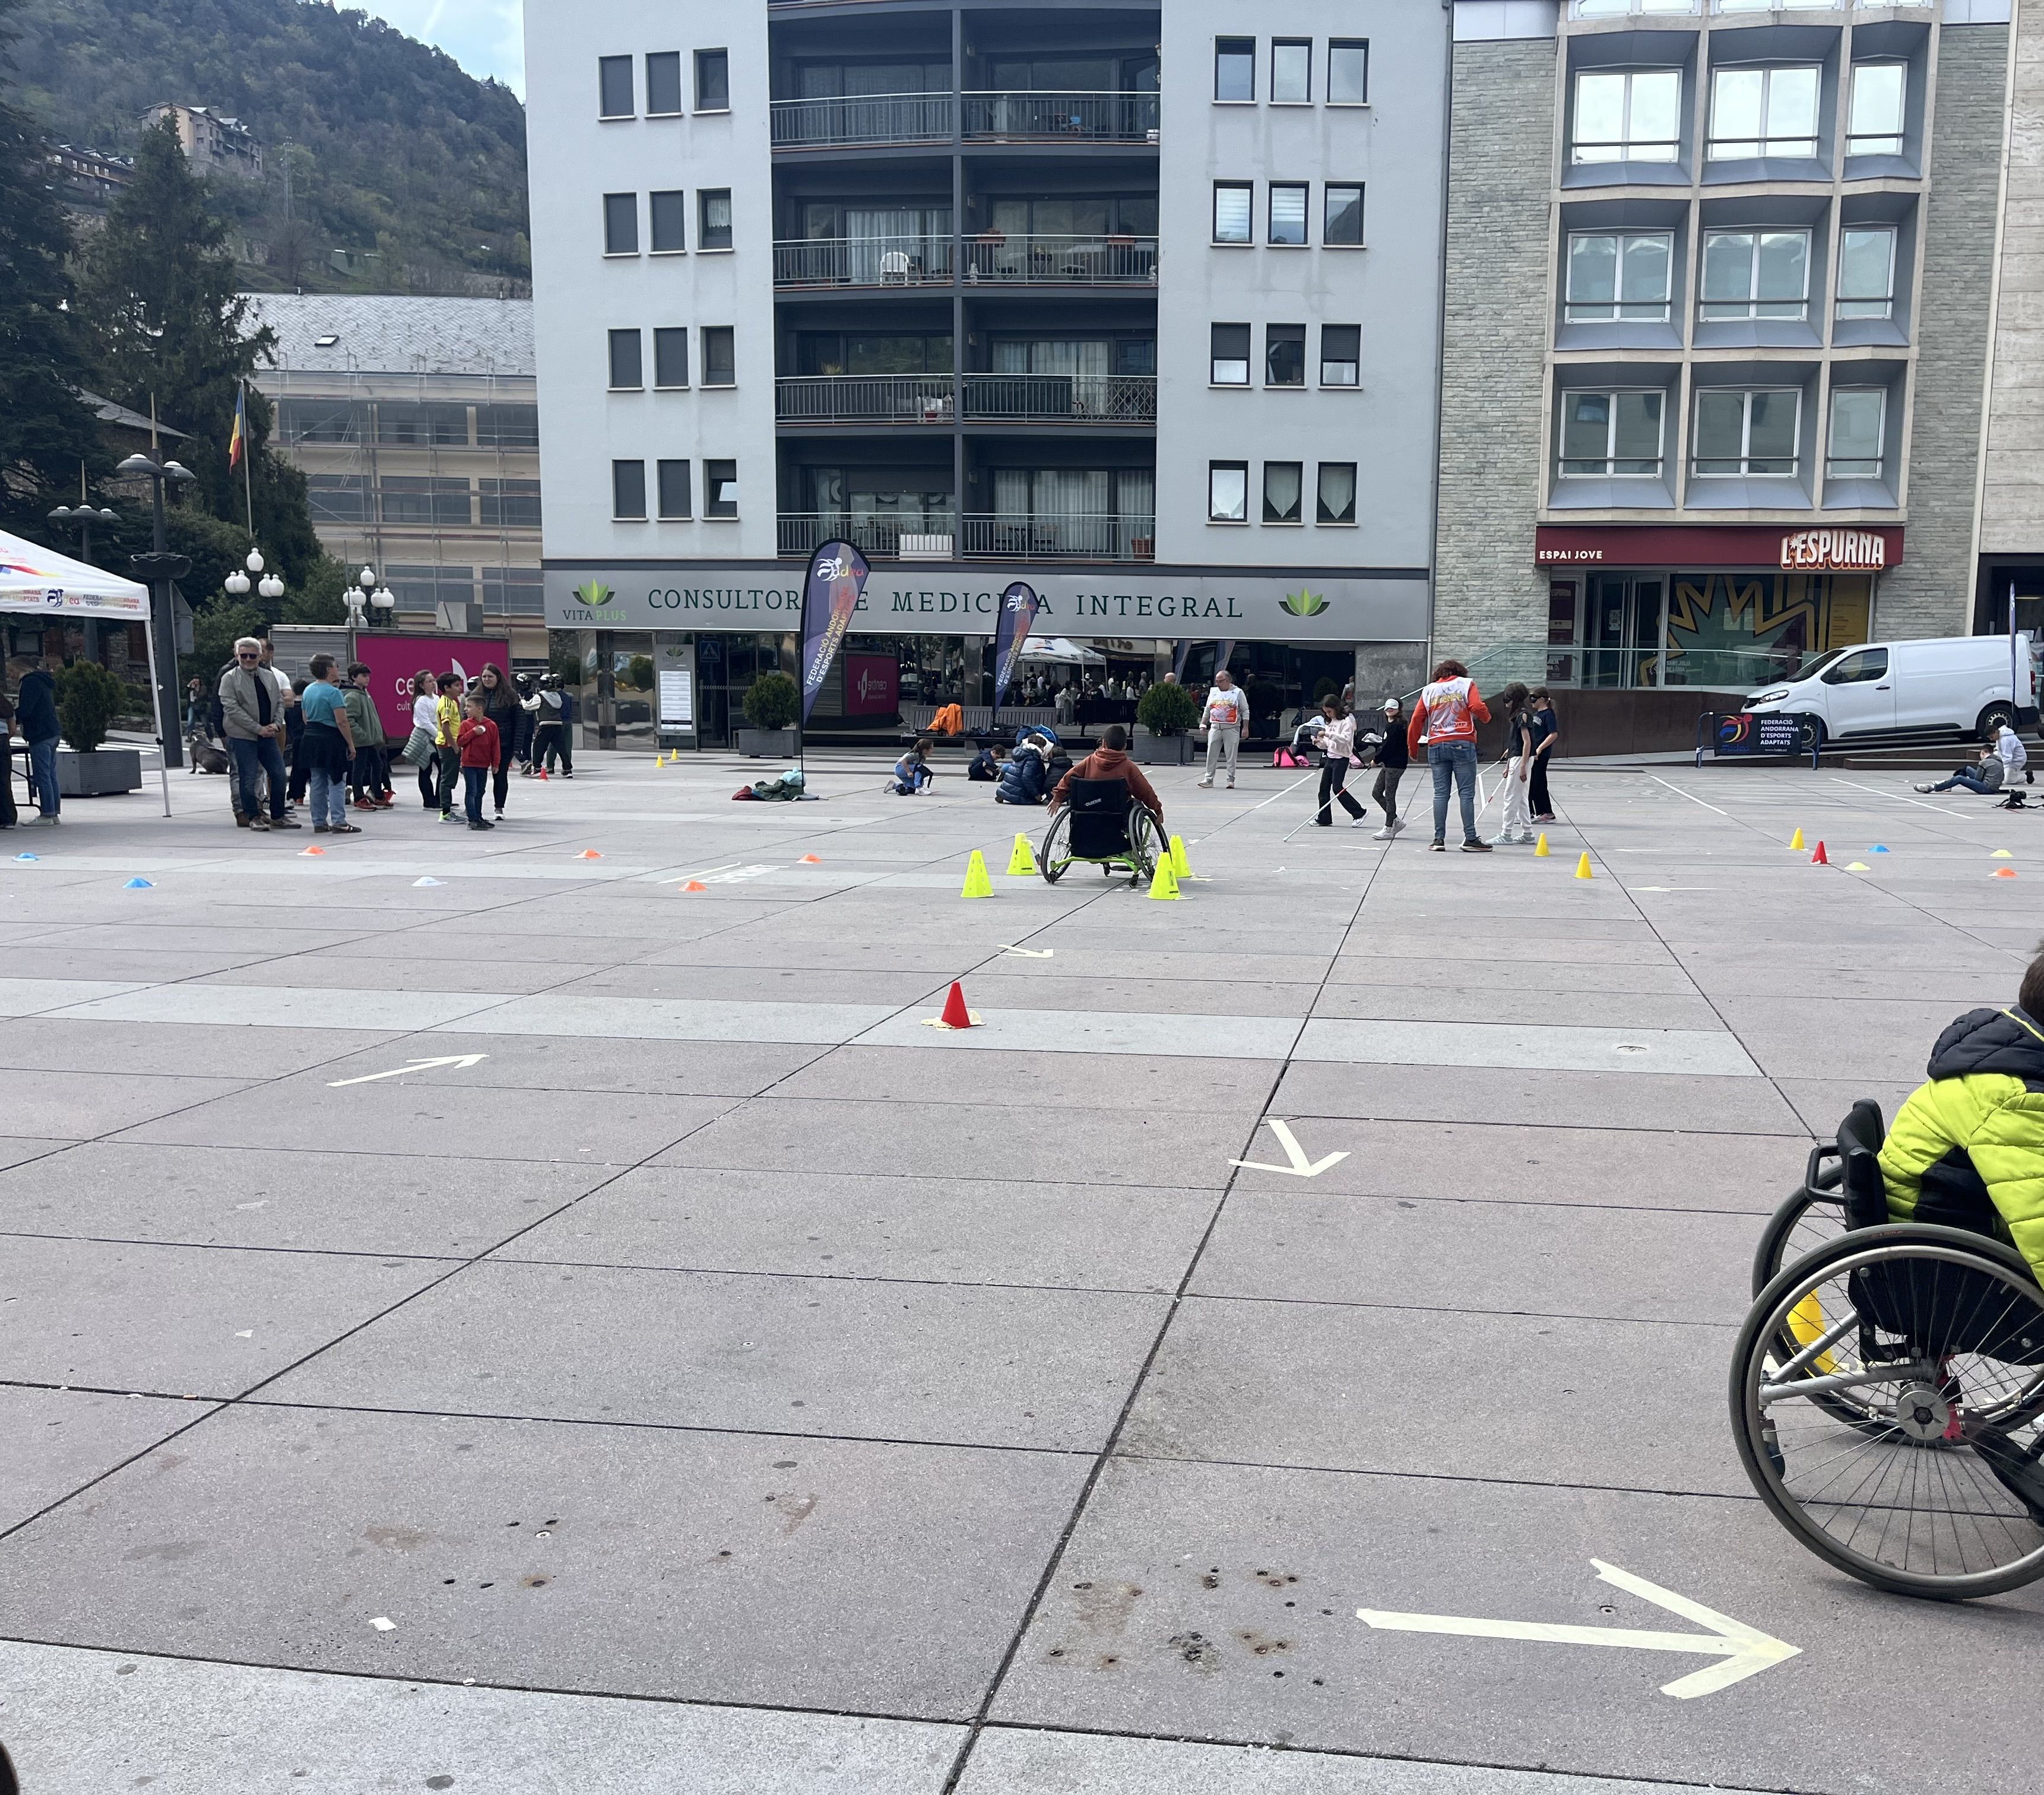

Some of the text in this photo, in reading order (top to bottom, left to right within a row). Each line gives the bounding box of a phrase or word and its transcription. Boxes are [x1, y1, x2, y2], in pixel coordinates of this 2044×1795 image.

[1539, 550, 1603, 559] ESPAI JOVE
[562, 610, 627, 621] VITA PLUS
[648, 589, 801, 610] CONSULTOR
[1076, 595, 1243, 618] INTEGRAL
[806, 638, 829, 686] FEDERACIÓ
[816, 637, 839, 683] D'ESPORTS
